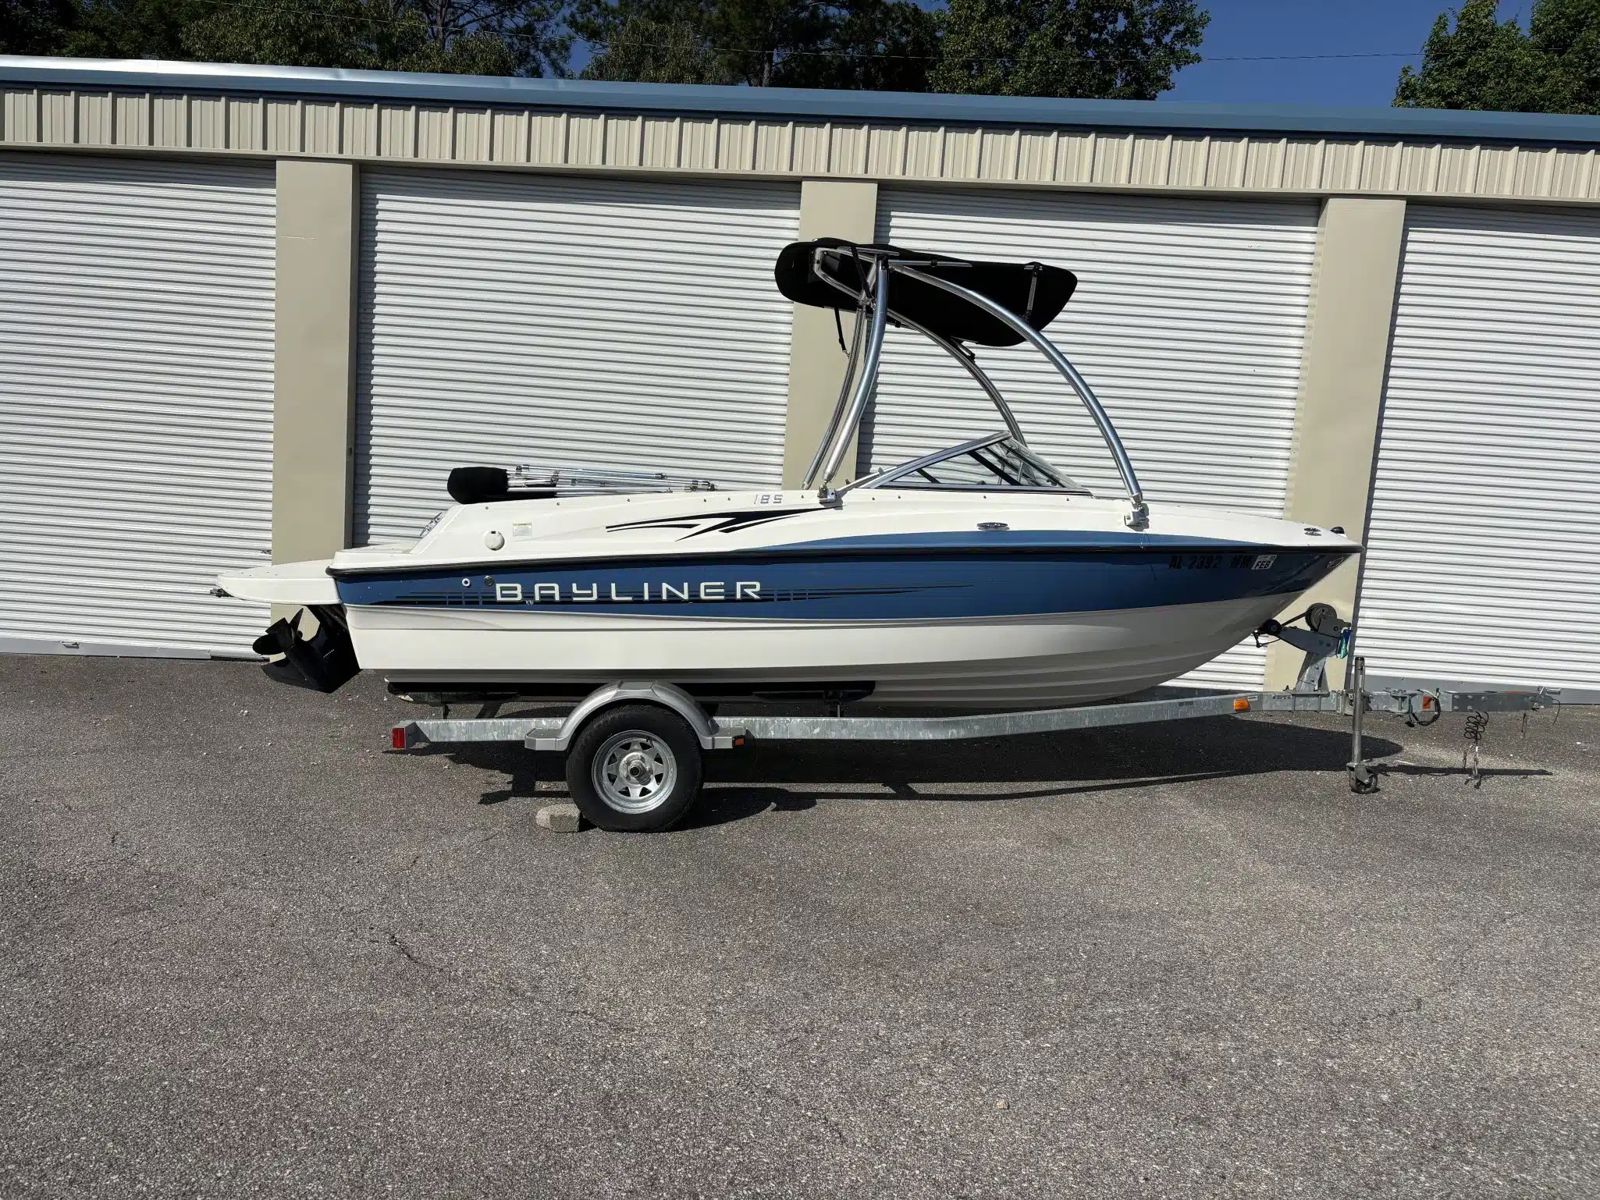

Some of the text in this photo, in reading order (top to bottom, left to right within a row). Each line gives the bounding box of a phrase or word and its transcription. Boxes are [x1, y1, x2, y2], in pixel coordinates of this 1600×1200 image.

[754, 494, 784, 505] 185
[1169, 555, 1184, 569] AL
[1254, 559, 1272, 570] FEB
[495, 581, 761, 601] BAYLINER
